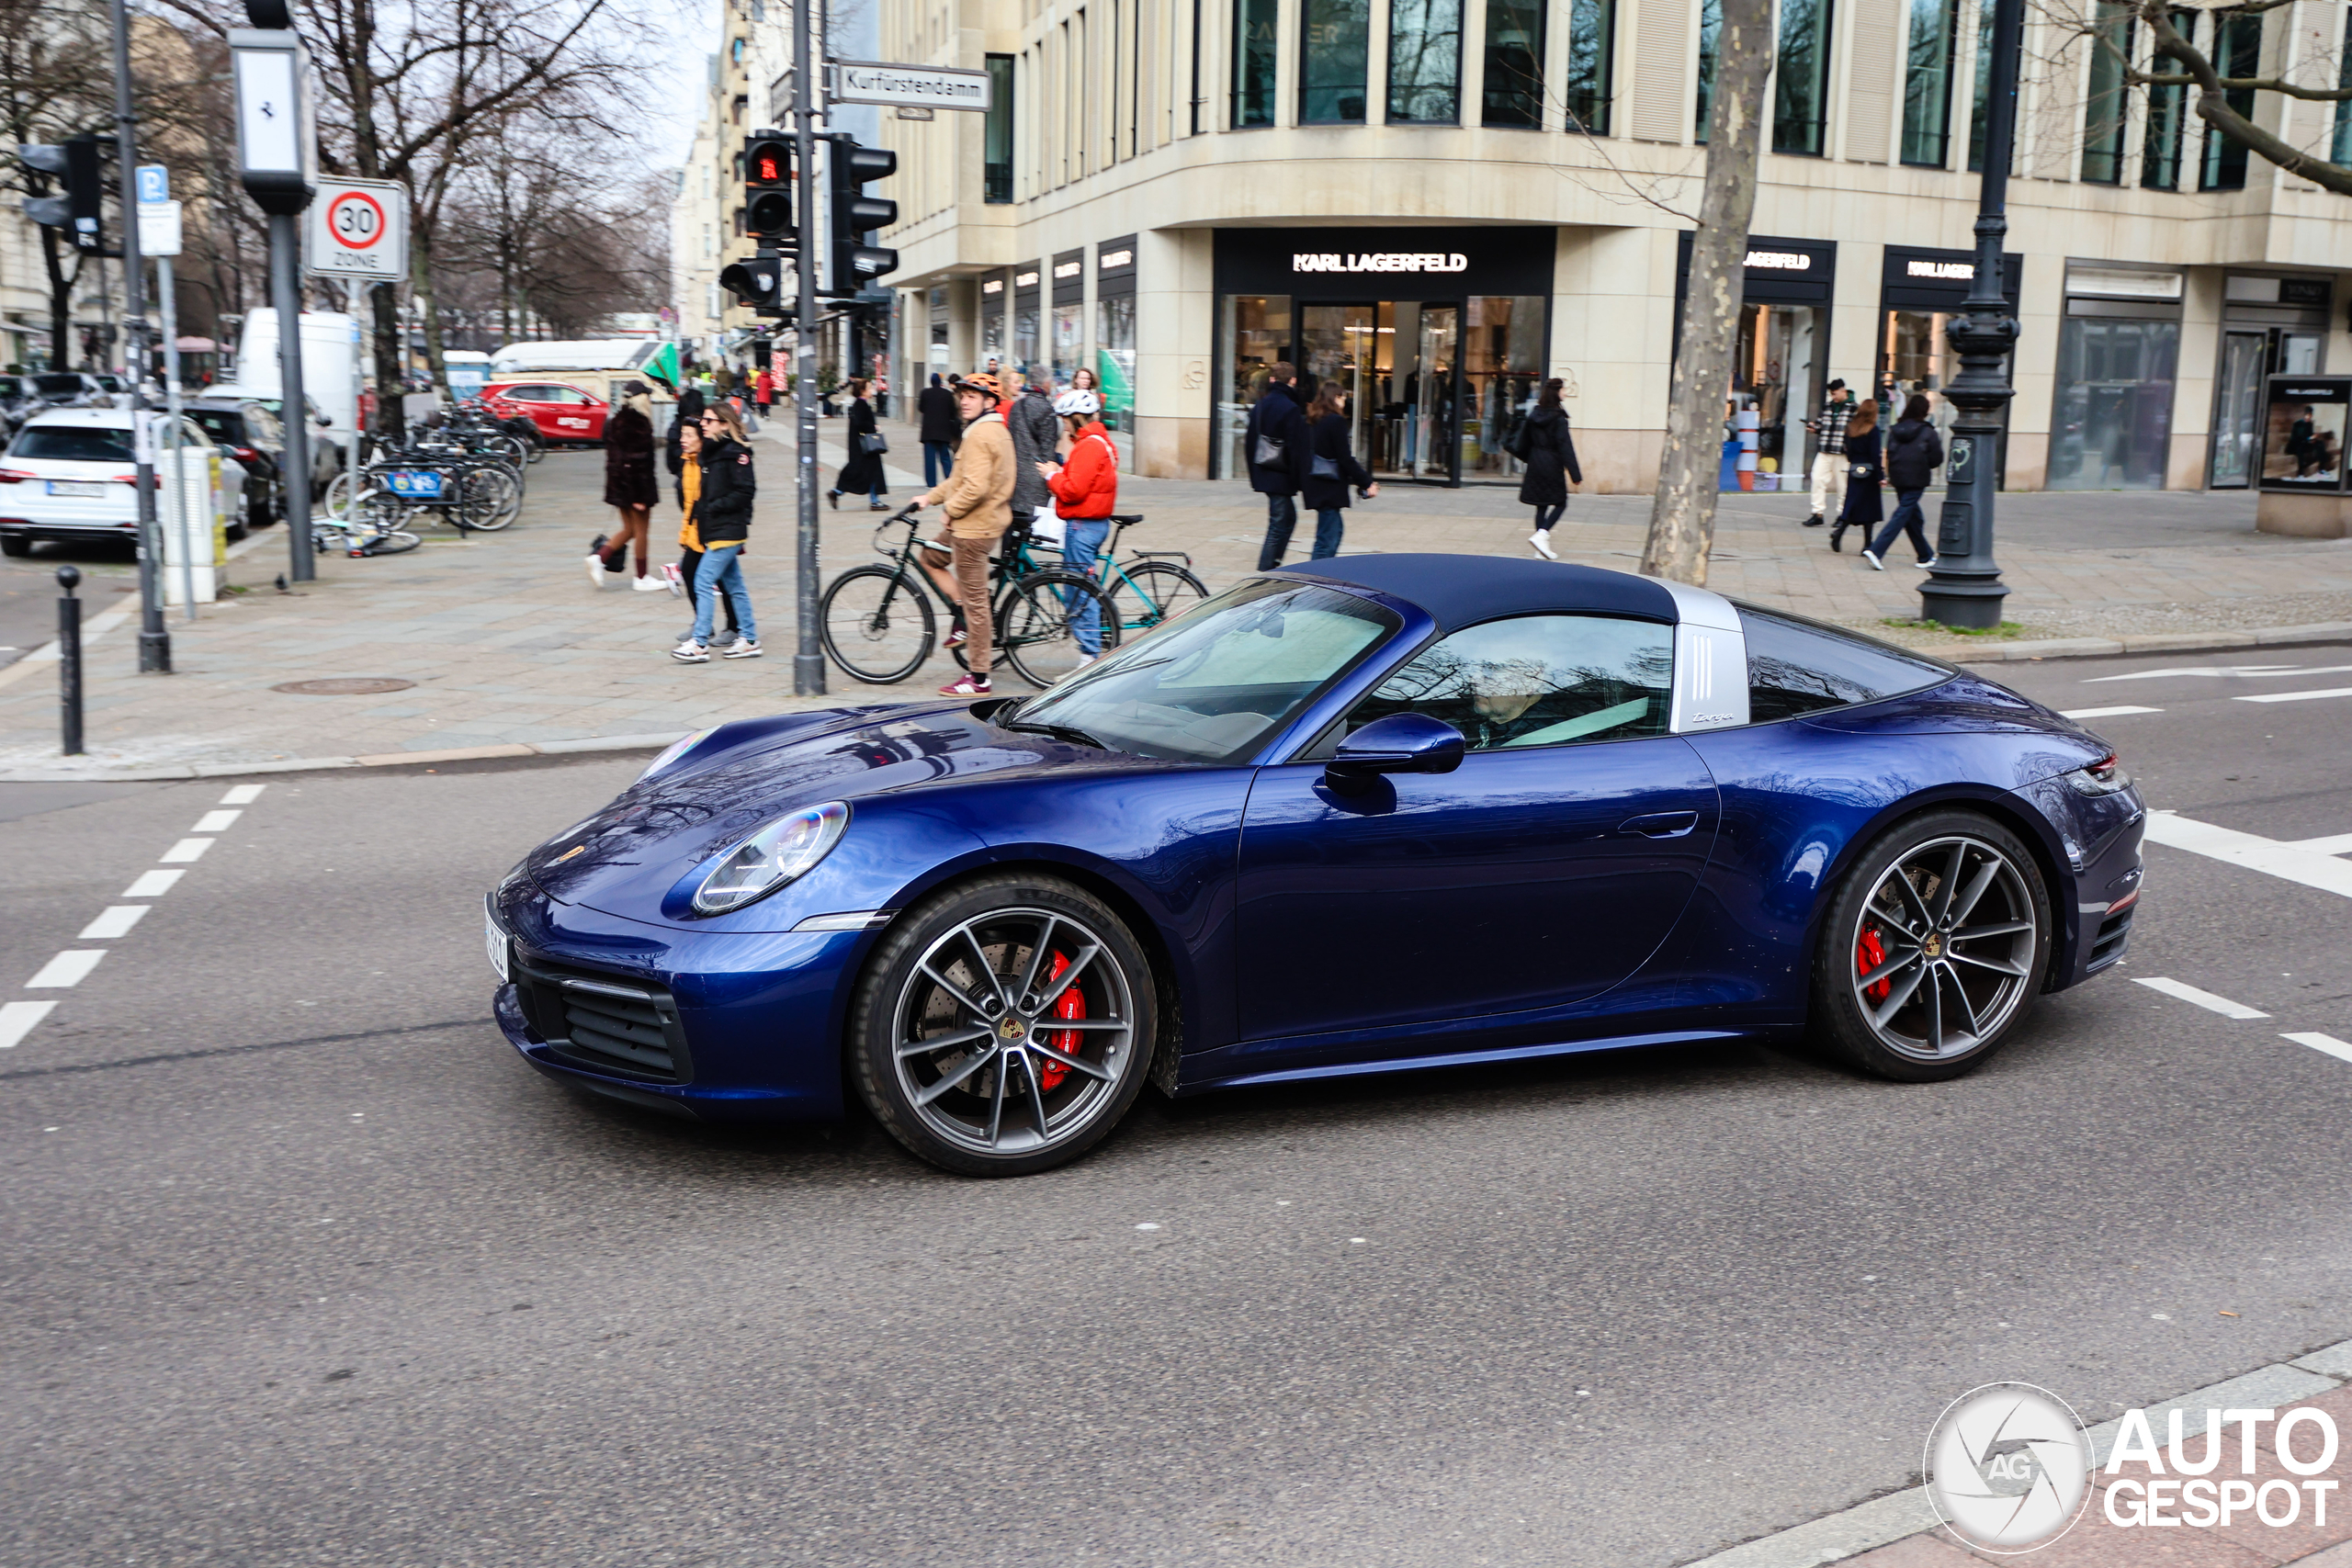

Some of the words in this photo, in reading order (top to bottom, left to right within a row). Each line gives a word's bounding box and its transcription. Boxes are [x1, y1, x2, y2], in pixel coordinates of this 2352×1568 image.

[846, 69, 982, 98] Kurfürstendamm
[339, 207, 374, 233] 30
[334, 252, 379, 268] ZONE
[1293, 254, 1347, 272] KARL
[1347, 253, 1468, 273] LAGERFELD
[1692, 712, 1735, 725] targa
[1064, 1003, 1074, 1054] POCHE
